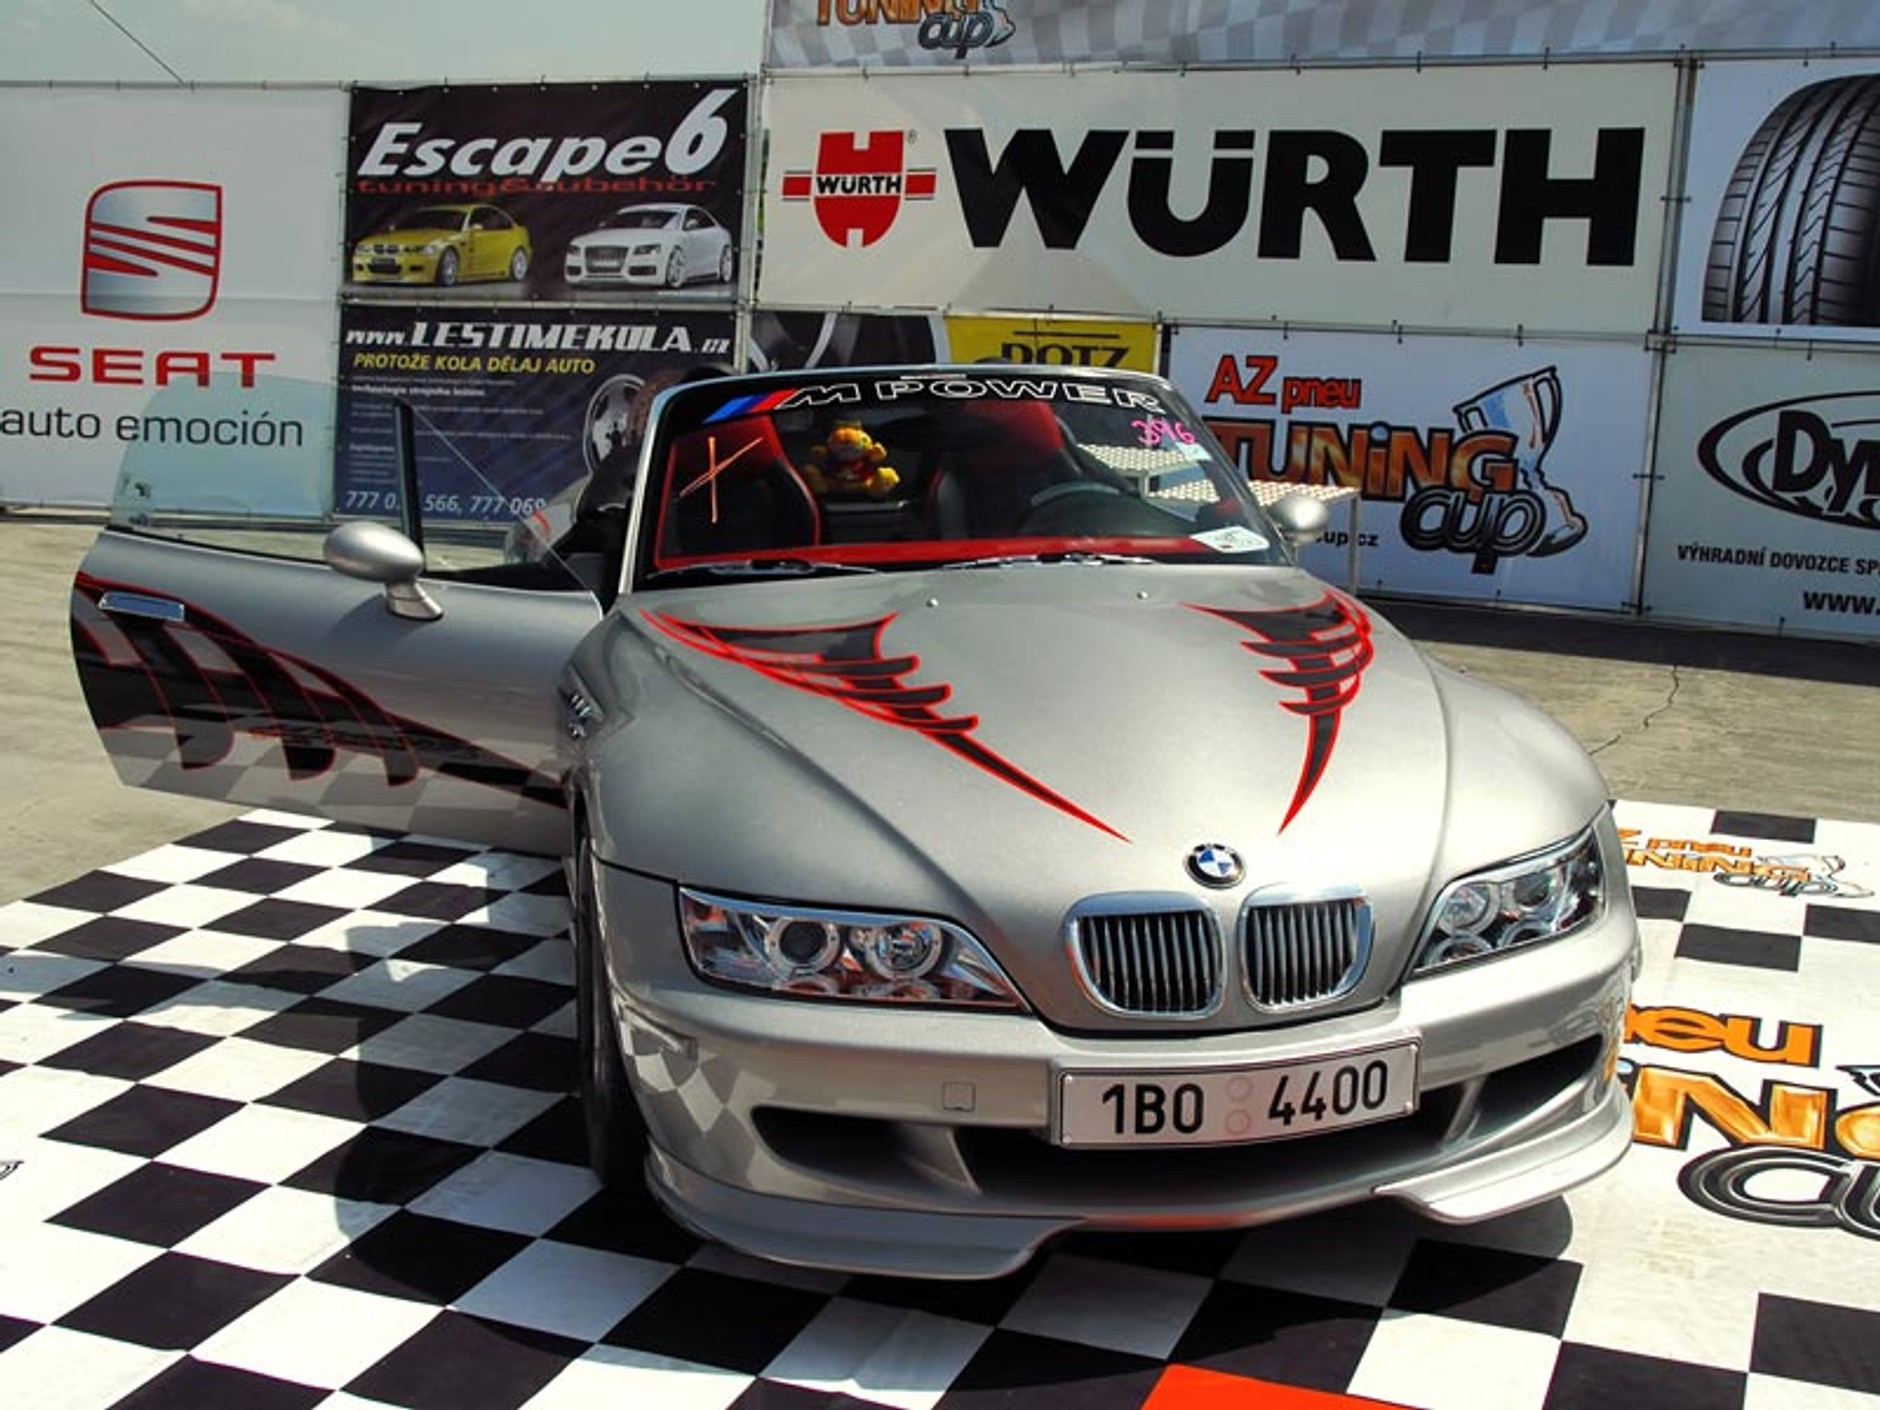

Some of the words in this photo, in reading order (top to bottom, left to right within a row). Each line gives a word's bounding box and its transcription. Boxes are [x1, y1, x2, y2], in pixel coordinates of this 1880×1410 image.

[357, 89, 739, 183] Escape6
[816, 175, 902, 195] WÜRTH
[944, 126, 1646, 267] WÜRTH
[29, 346, 276, 388] SEAT
[353, 352, 431, 371] PROTOŽE
[434, 354, 482, 372] KOLA
[547, 357, 597, 375] AUTO
[1204, 354, 1279, 405] AZ
[1281, 376, 1362, 414] pneu
[775, 382, 861, 410] M
[875, 379, 1166, 414] POWER
[0, 407, 101, 439] auto
[115, 410, 304, 447] emoción
[345, 491, 380, 509] 777
[1400, 484, 1549, 575] cup
[1678, 541, 1766, 567] VÝHRADNÍ
[1770, 551, 1850, 574] DOVOZCE
[1854, 558, 1880, 577] SP
[1268, 1059, 1389, 1127] 4400
